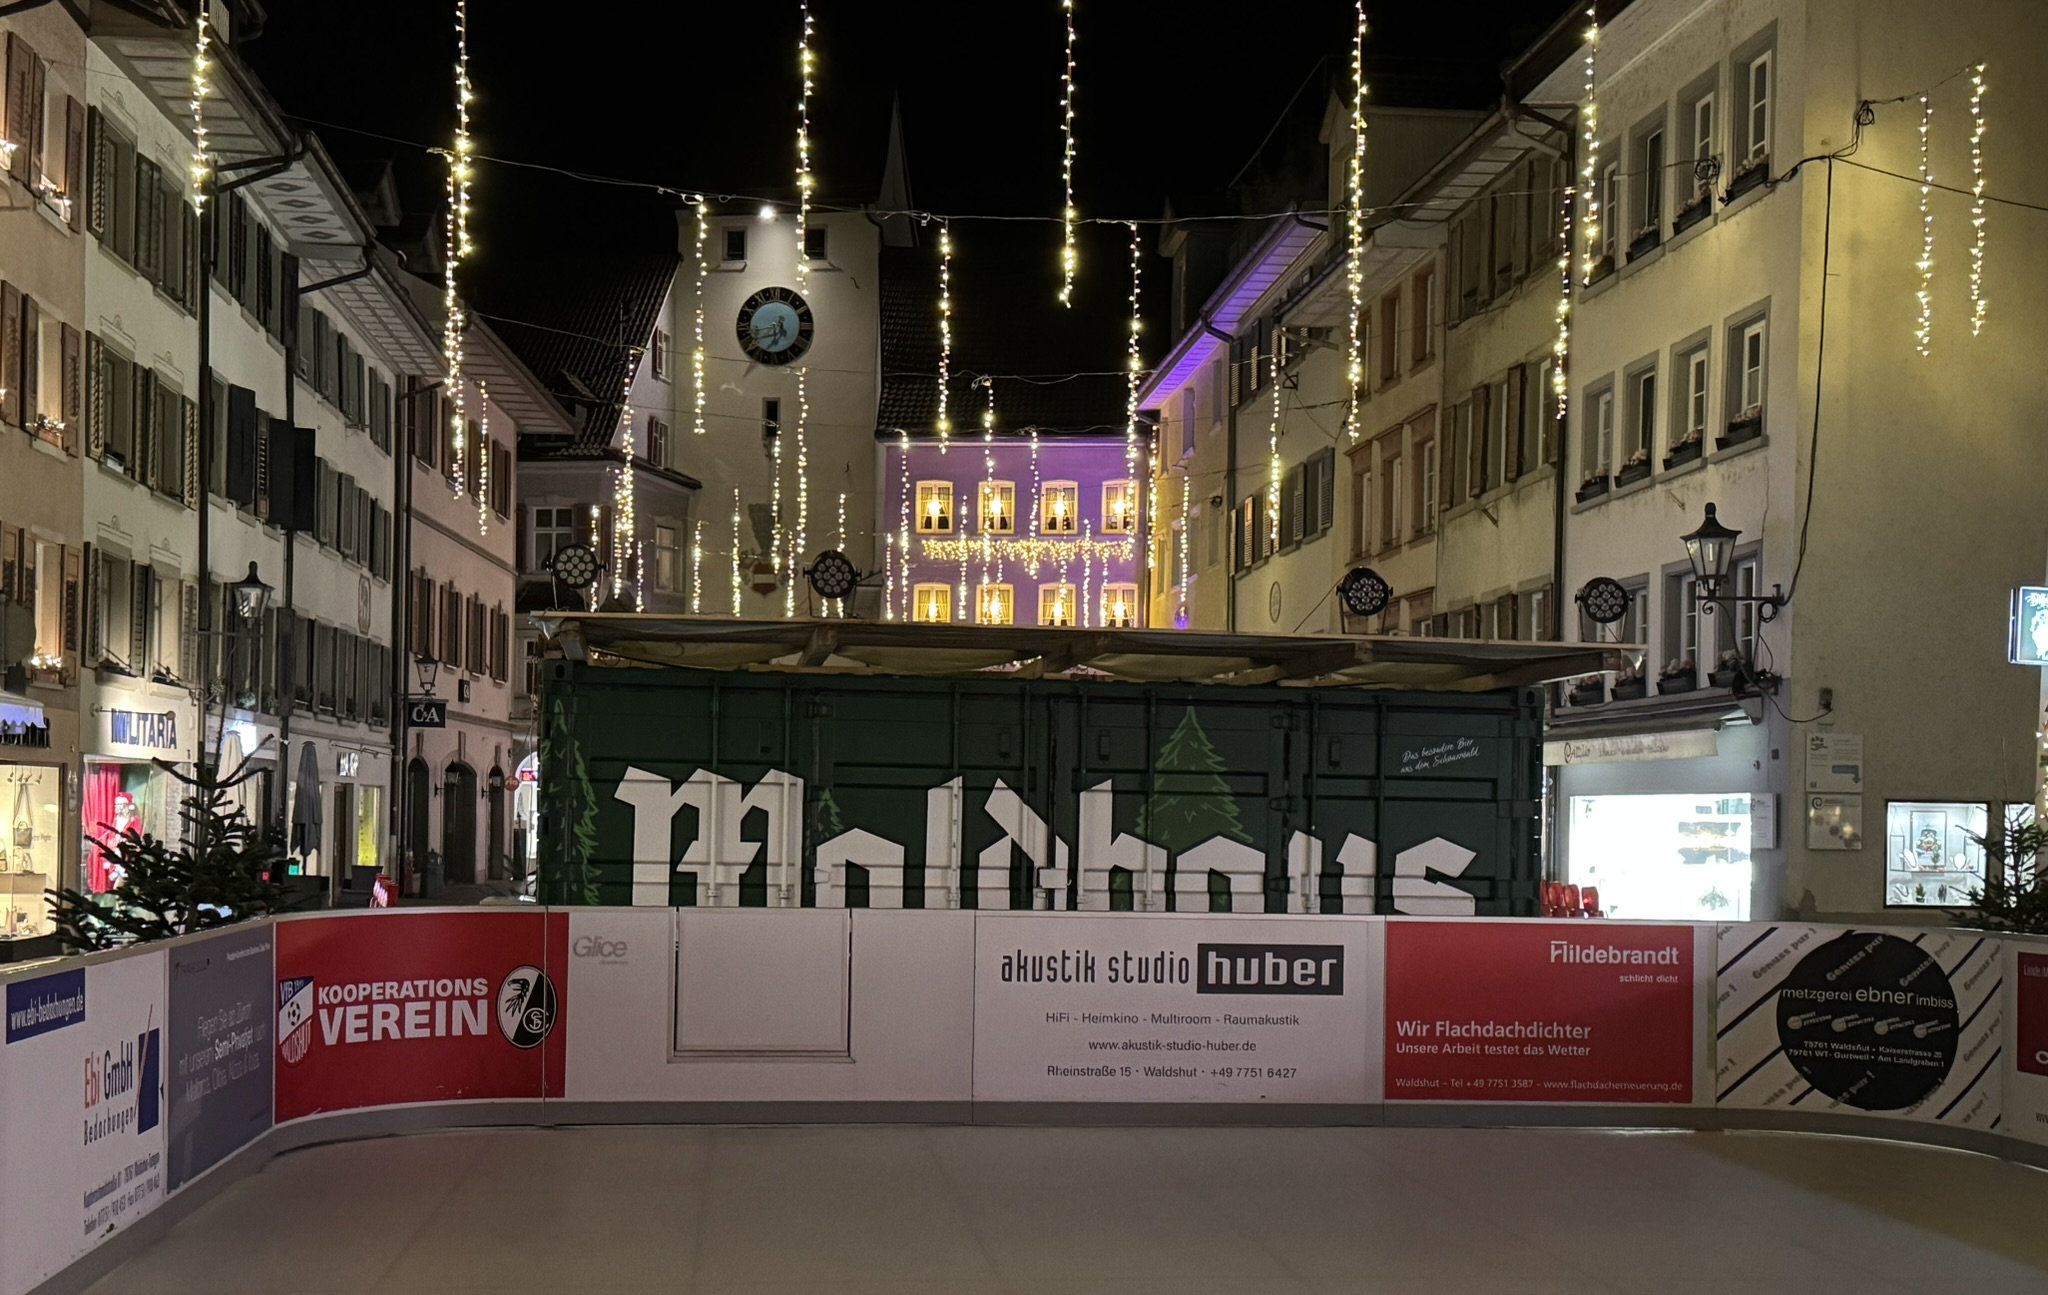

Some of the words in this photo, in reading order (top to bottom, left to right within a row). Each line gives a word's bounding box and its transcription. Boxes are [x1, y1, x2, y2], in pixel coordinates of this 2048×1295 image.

[110, 707, 177, 750] MILITARIA
[572, 936, 628, 958] Glice
[1001, 949, 1096, 984] akustik
[1108, 950, 1190, 984] studio
[1207, 951, 1338, 986] huber
[1619, 974, 1654, 984] schlicht
[318, 977, 489, 1005] KOOPERATIONS
[1782, 988, 1852, 1002] metzgerei
[1855, 985, 1915, 1005] ebner
[1915, 994, 1954, 1009] imbiss
[318, 1000, 488, 1046] VEREIN
[1046, 1012, 1070, 1024] HiFi
[1082, 1013, 1139, 1025] Heimkino
[1151, 1013, 1212, 1026] Multiroom
[1224, 1014, 1300, 1026] Raumakustik
[1396, 1020, 1429, 1038] Wir
[1435, 1020, 1592, 1040] Flachdachdichter
[1088, 1039, 1257, 1052] www.akustik-studio-huber.de
[1396, 1042, 1439, 1055] Unsere
[1442, 1042, 1481, 1055] Arbeit
[1484, 1043, 1520, 1056] testet
[1523, 1044, 1545, 1056] das
[1548, 1044, 1591, 1057] Wetter
[84, 1051, 100, 1109] Ebi
[104, 1041, 133, 1100] GmbH
[1047, 1065, 1117, 1078] Rheinstraße
[1120, 1066, 1132, 1078] 15
[1143, 1066, 1198, 1078] Waldshut
[1210, 1067, 1234, 1079] +49
[1236, 1067, 1263, 1079] 7751
[1267, 1067, 1297, 1079] 6427
[1395, 1077, 1440, 1088] Waldshut
[1450, 1078, 1464, 1088] Tel
[1487, 1079, 1509, 1089] 7751
[1511, 1079, 1534, 1089] 3587
